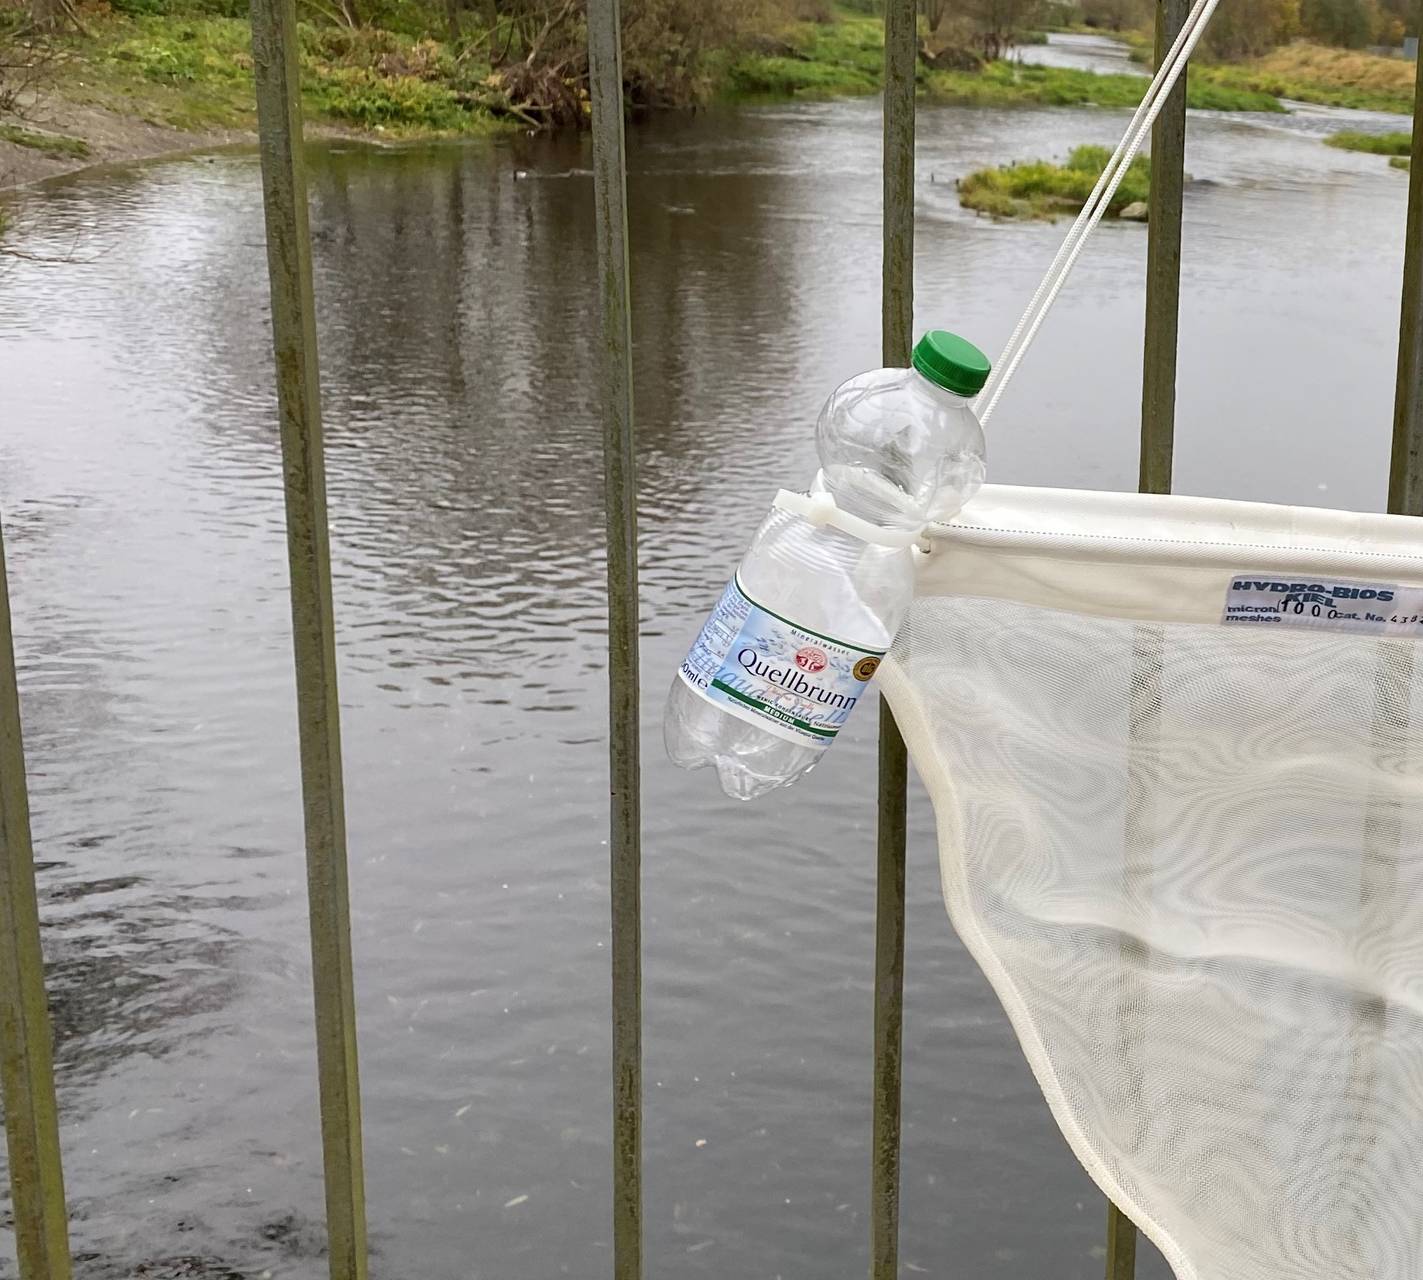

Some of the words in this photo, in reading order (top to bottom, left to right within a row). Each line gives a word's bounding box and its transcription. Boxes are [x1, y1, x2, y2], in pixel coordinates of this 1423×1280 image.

[1232, 581, 1394, 601] HYDRO-BIOS
[1285, 592, 1337, 608] KIEL
[1226, 614, 1282, 622] meshes
[1227, 604, 1278, 613] micron
[1365, 612, 1386, 622] No.
[738, 648, 857, 710] Quellbrunn
[763, 705, 796, 725] MEDIUM
